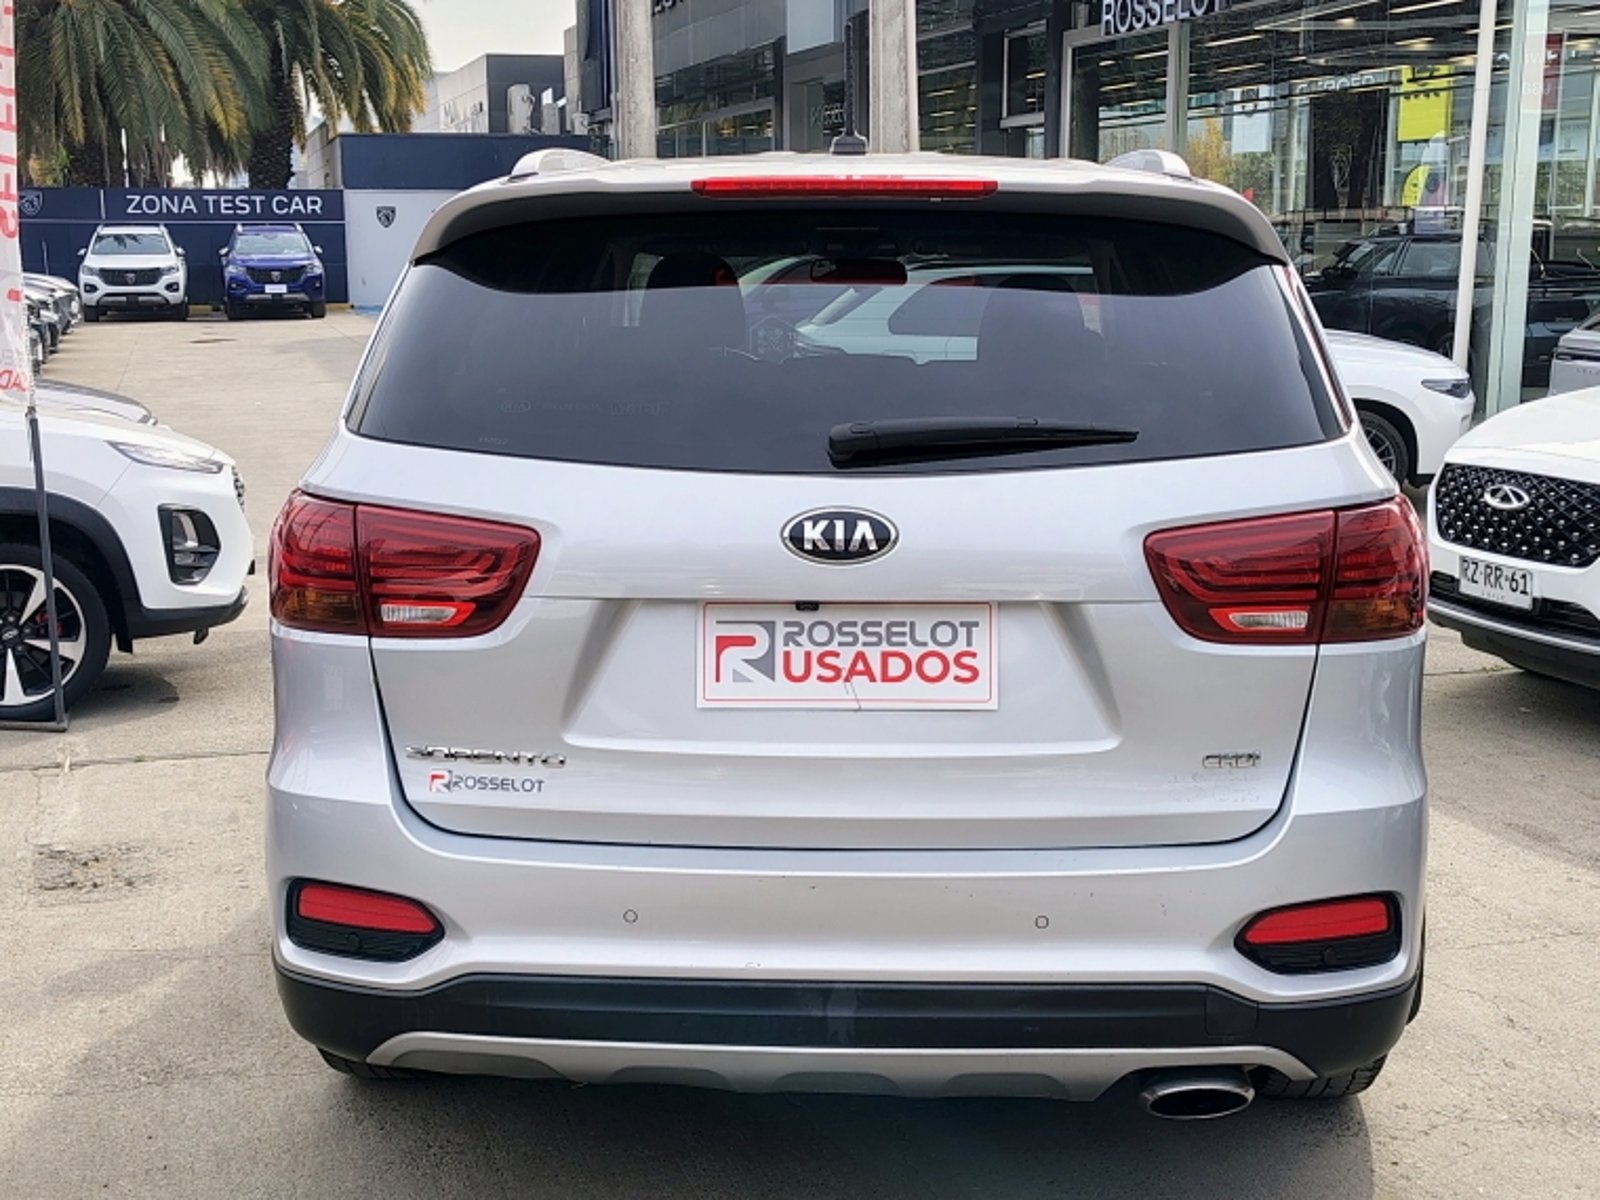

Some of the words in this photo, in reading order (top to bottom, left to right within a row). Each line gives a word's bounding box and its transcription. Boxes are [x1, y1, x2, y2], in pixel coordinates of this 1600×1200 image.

[126, 194, 198, 214] ZONA
[202, 195, 266, 214] TEST
[272, 195, 323, 214] CAR
[802, 519, 878, 551] KIA
[782, 620, 981, 648] ROSSELOT
[782, 650, 981, 684] USADOS
[452, 776, 545, 793] ROSSELOT
